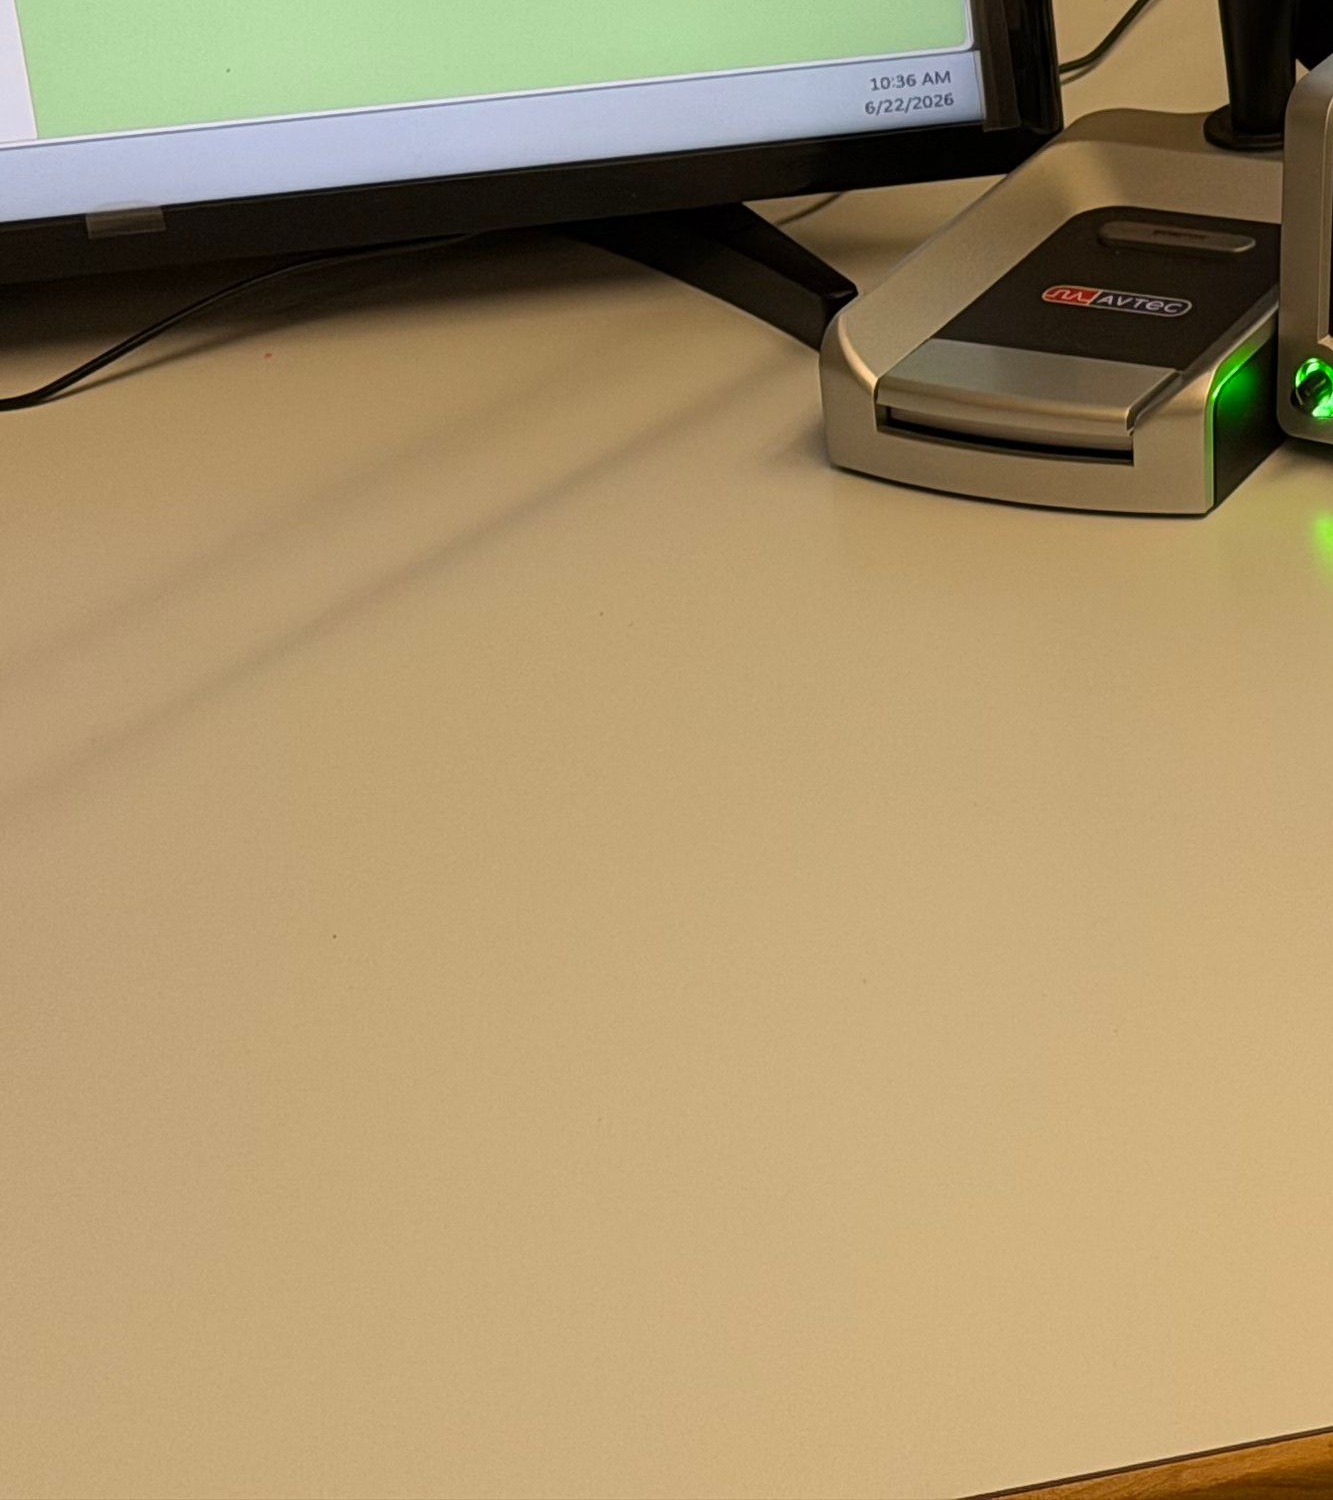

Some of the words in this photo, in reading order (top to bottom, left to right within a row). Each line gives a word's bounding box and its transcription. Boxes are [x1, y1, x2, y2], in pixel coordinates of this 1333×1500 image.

[869, 73, 917, 92] 10:36
[922, 69, 952, 87] AM
[864, 92, 955, 116] 6/22/2026
